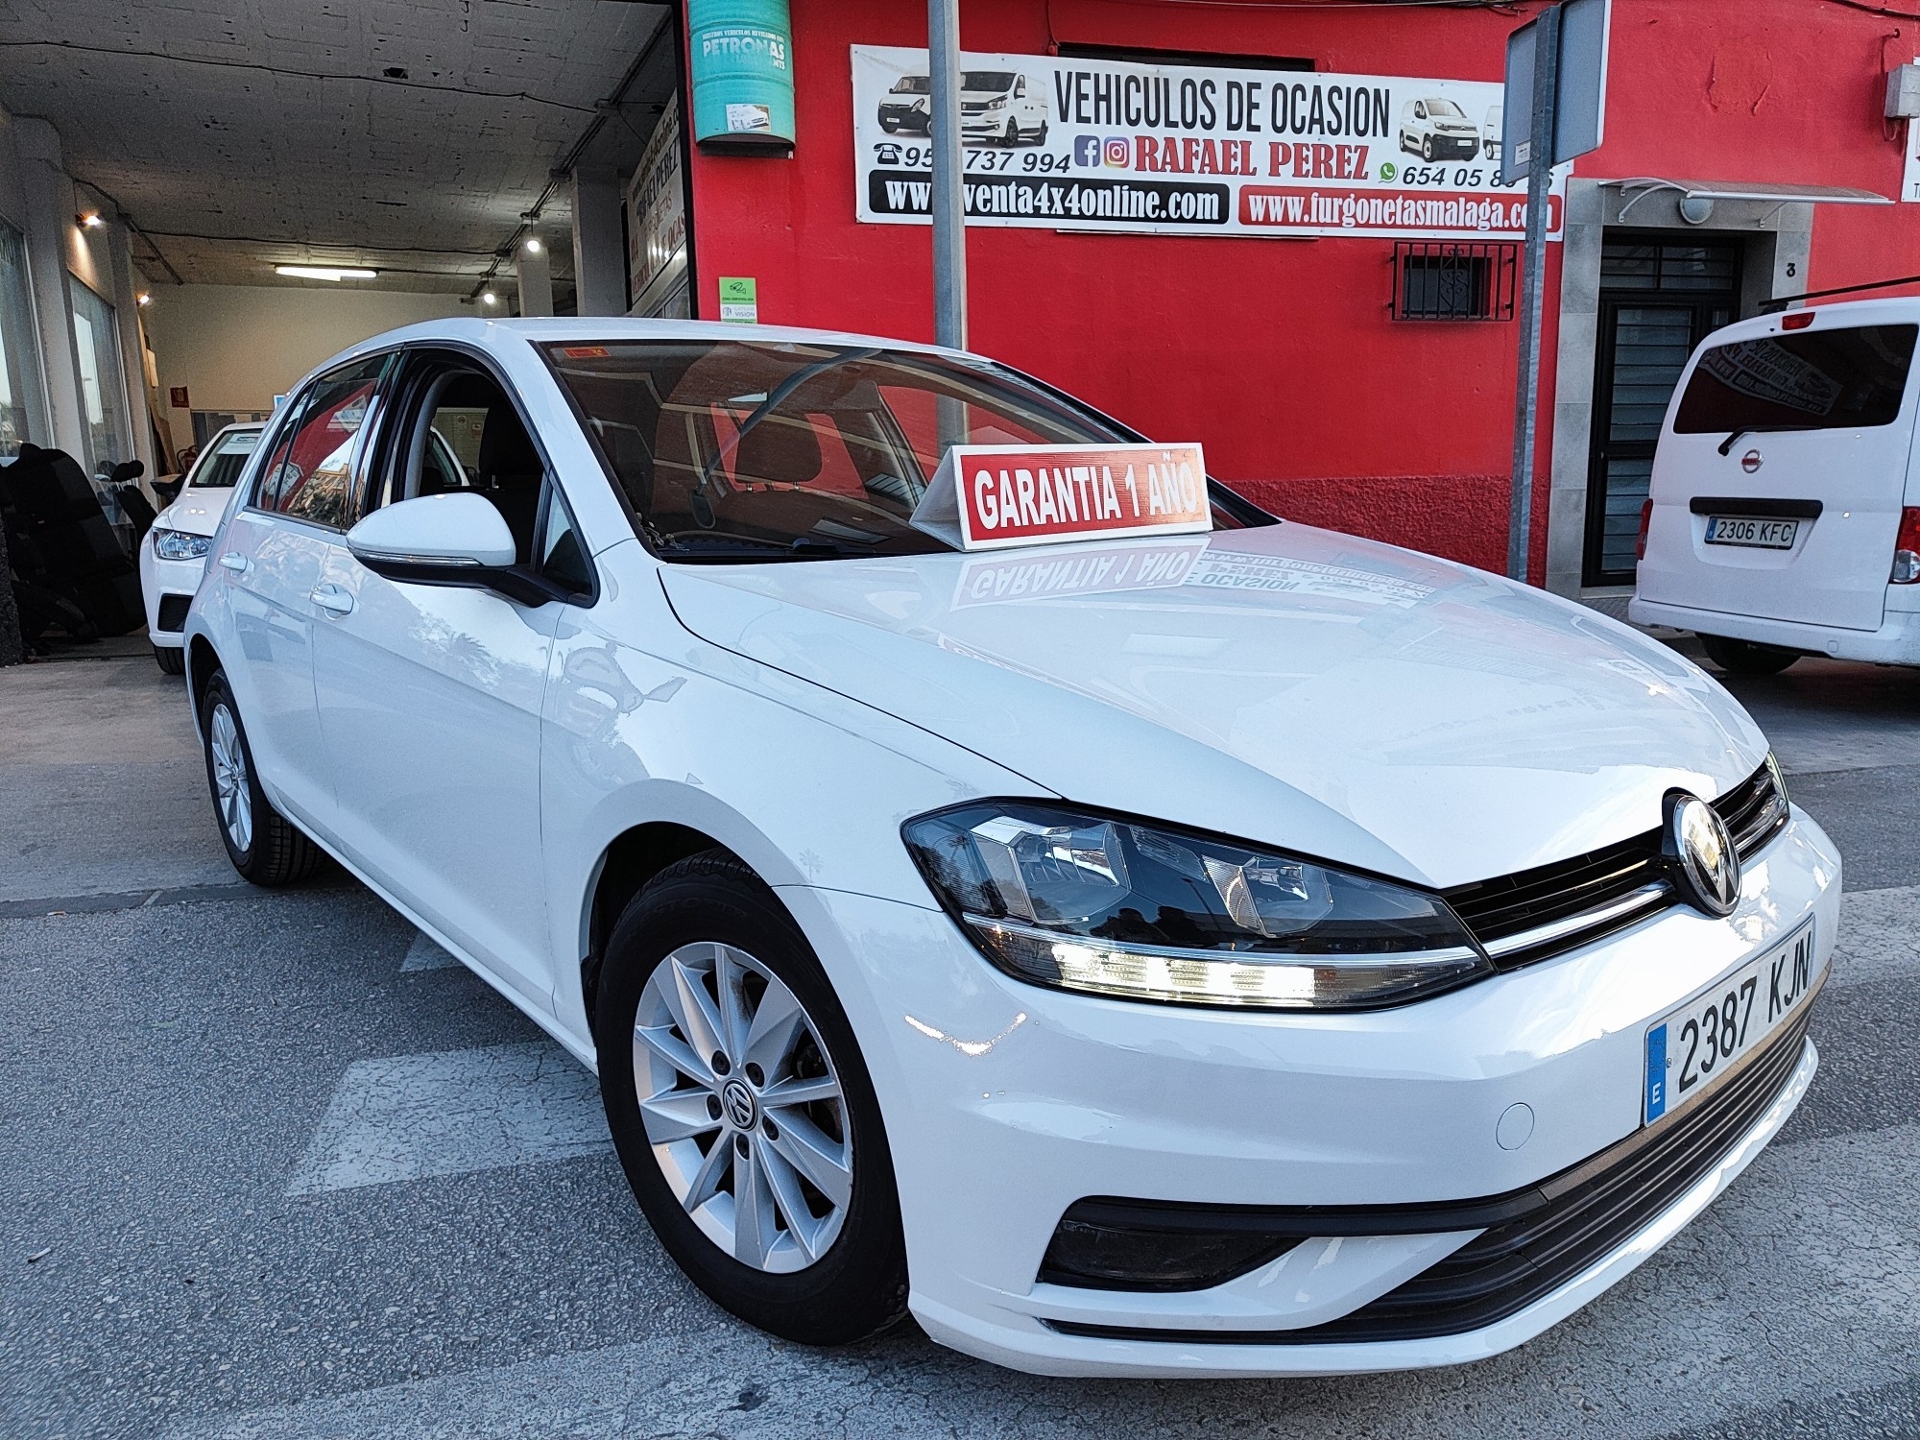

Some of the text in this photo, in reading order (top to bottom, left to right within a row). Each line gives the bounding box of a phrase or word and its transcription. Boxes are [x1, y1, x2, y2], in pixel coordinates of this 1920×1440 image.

[703, 36, 785, 60] PETRONAS
[1054, 70, 1390, 138] VEHICULOS DE OCASION
[904, 147, 1071, 174] 95 737 994
[1135, 135, 1369, 180] RAFAEL PEREZ
[1402, 166, 1445, 186] 654
[1454, 169, 1481, 187] 05
[885, 180, 1219, 220] wwventa4x4online.com
[1249, 191, 1553, 231] www.furgonetasmalaga.co
[1786, 263, 1796, 278] 3
[974, 451, 1198, 530] GARANTIA 1 AÑO
[1717, 521, 1756, 540] 2306
[1759, 523, 1792, 542] KFC
[1679, 930, 1811, 1093] 2387 KJN
[1652, 1081, 1661, 1105] E
